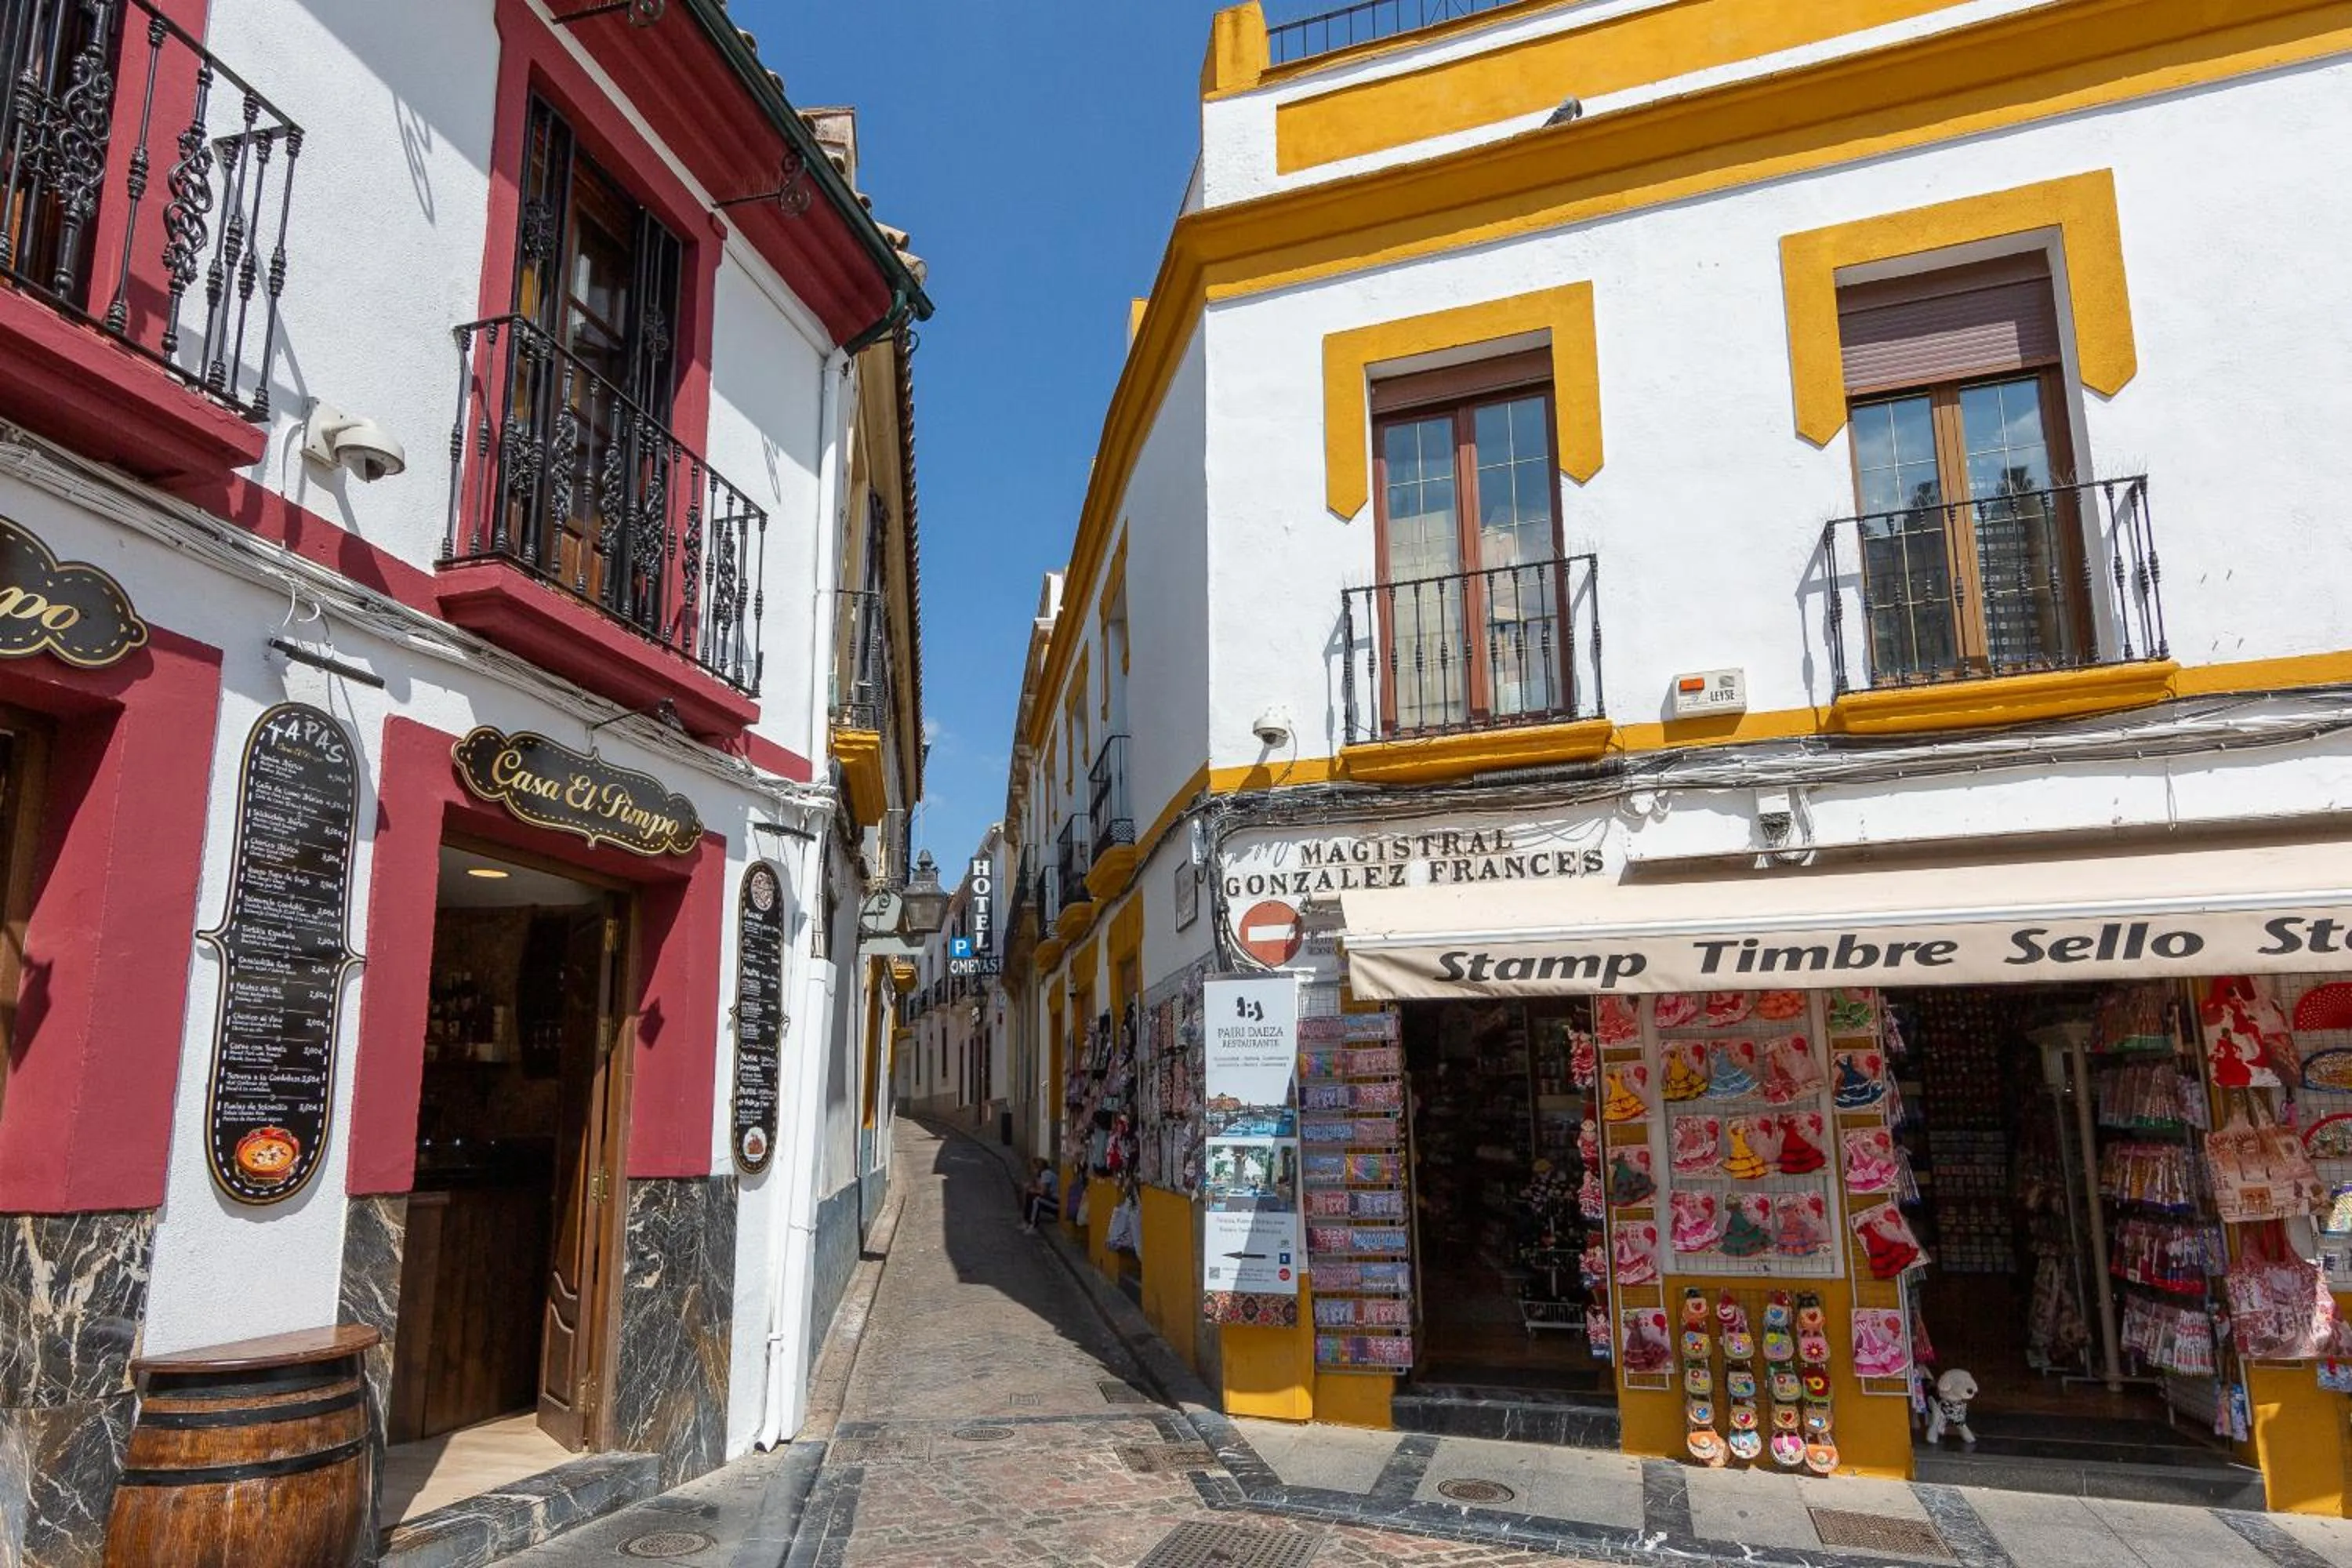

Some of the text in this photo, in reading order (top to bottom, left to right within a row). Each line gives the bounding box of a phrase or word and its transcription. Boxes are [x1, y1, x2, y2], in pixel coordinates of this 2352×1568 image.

[0, 586, 79, 630] po
[265, 719, 346, 763] TAPAS
[492, 750, 678, 840] Casa El Pimpo
[1301, 829, 1512, 866] MAGISTRAL
[1225, 849, 1604, 896] GONZALEZ FRANCES
[972, 860, 991, 949] HOTEL
[949, 958, 998, 975] OMEYAS
[954, 940, 967, 955] P
[1433, 950, 1647, 989] Stamp
[1692, 934, 1958, 974] Timbre
[2004, 921, 2205, 964] Sello
